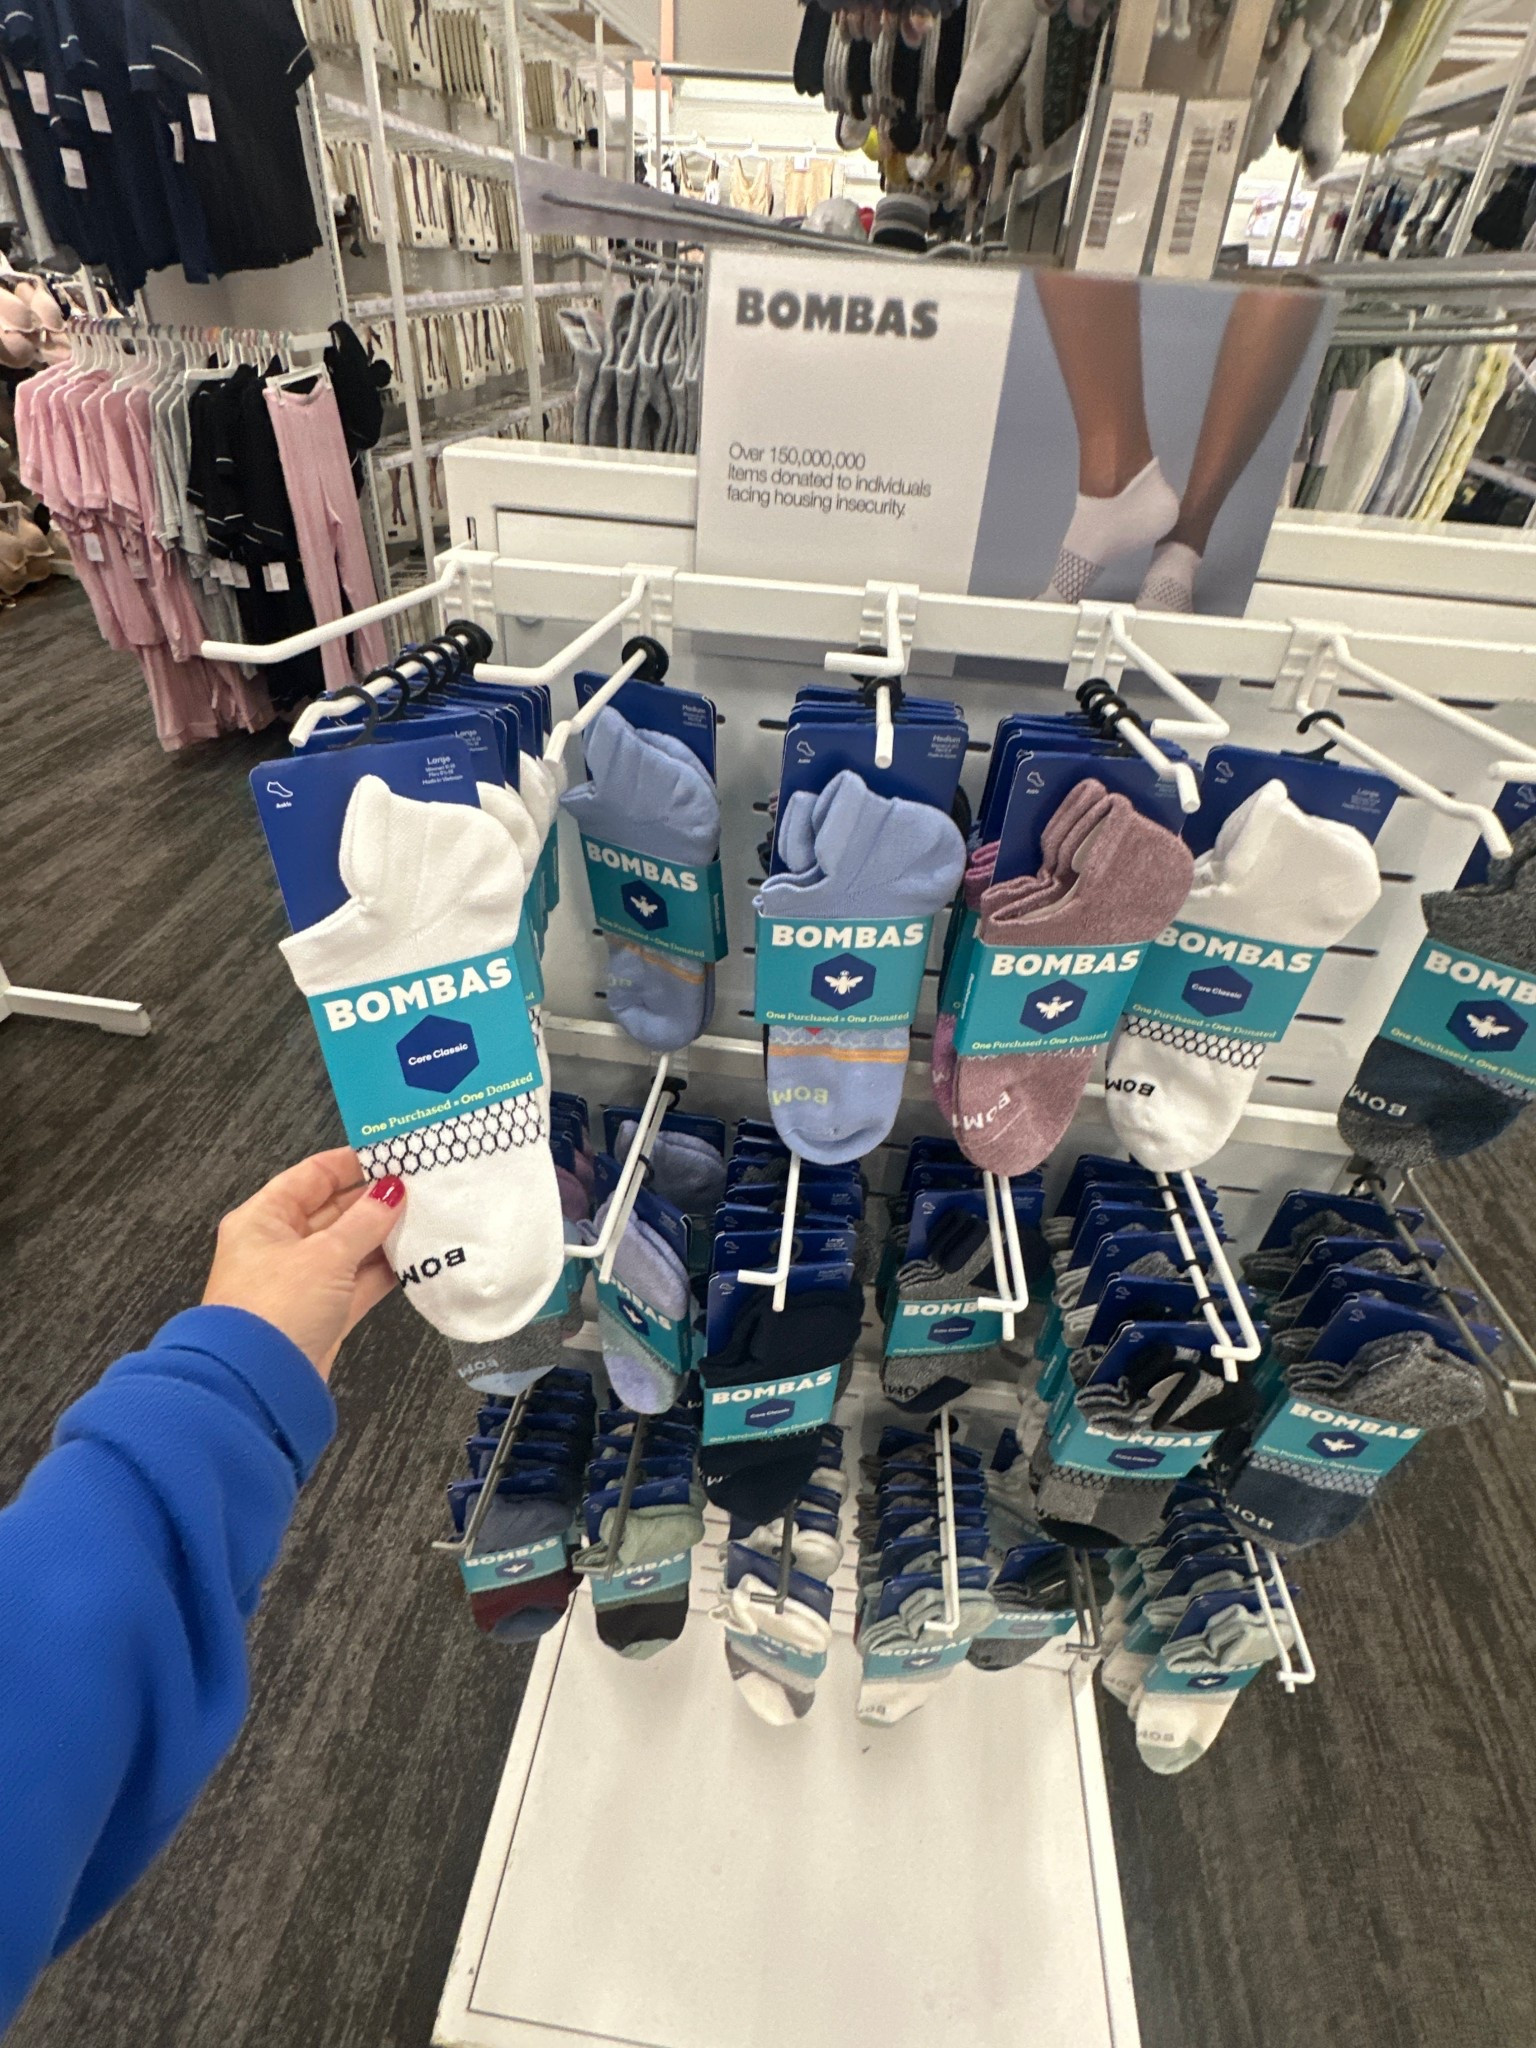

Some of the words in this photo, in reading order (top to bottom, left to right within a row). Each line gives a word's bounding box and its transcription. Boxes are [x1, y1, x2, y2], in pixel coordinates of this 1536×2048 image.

[736, 287, 939, 340] BOMBAS
[729, 441, 764, 461] Over
[770, 446, 866, 471] 150,000,000
[771, 468, 833, 489] donated
[837, 473, 851, 490] to
[855, 476, 932, 497] individuals
[727, 485, 770, 508] facing
[774, 487, 832, 513] housing
[836, 494, 906, 519] insecurity.
[427, 756, 451, 765] Large
[586, 841, 698, 892] BOMBAS
[772, 924, 924, 949] BOMBAS
[1154, 927, 1313, 973] BOMBAS
[991, 950, 1140, 976] BOMBAS
[1423, 949, 1536, 1005] BOMB
[322, 957, 512, 1032] BOMBAS
[766, 1010, 786, 1020] One
[787, 1012, 838, 1023] Purchased
[847, 1014, 867, 1023] One
[869, 1012, 909, 1023] Donated
[1132, 1003, 1152, 1015] One
[1153, 1008, 1204, 1027] Purchased
[1211, 1022, 1231, 1033] One
[1233, 1025, 1276, 1039] Donated
[408, 1054, 432, 1066] Core
[433, 1043, 468, 1060] Classic
[971, 1041, 991, 1050] One
[992, 1038, 1042, 1050] Purchased
[1049, 1037, 1067, 1045] One
[1069, 1031, 1107, 1044] Donated
[1391, 1027, 1412, 1041] One
[1413, 1035, 1468, 1061] Purchased
[1475, 1058, 1500, 1073] One
[361, 1122, 387, 1136] One
[388, 1099, 452, 1128] Purchased
[460, 1091, 484, 1105] One
[486, 1072, 533, 1097] Donated
[771, 1086, 829, 1106] BOM
[903, 1302, 984, 1317] BOMB
[712, 1371, 833, 1405] BOMBAS
[1289, 1403, 1421, 1440] BOMBAS
[465, 1538, 559, 1568] BOMBAS
